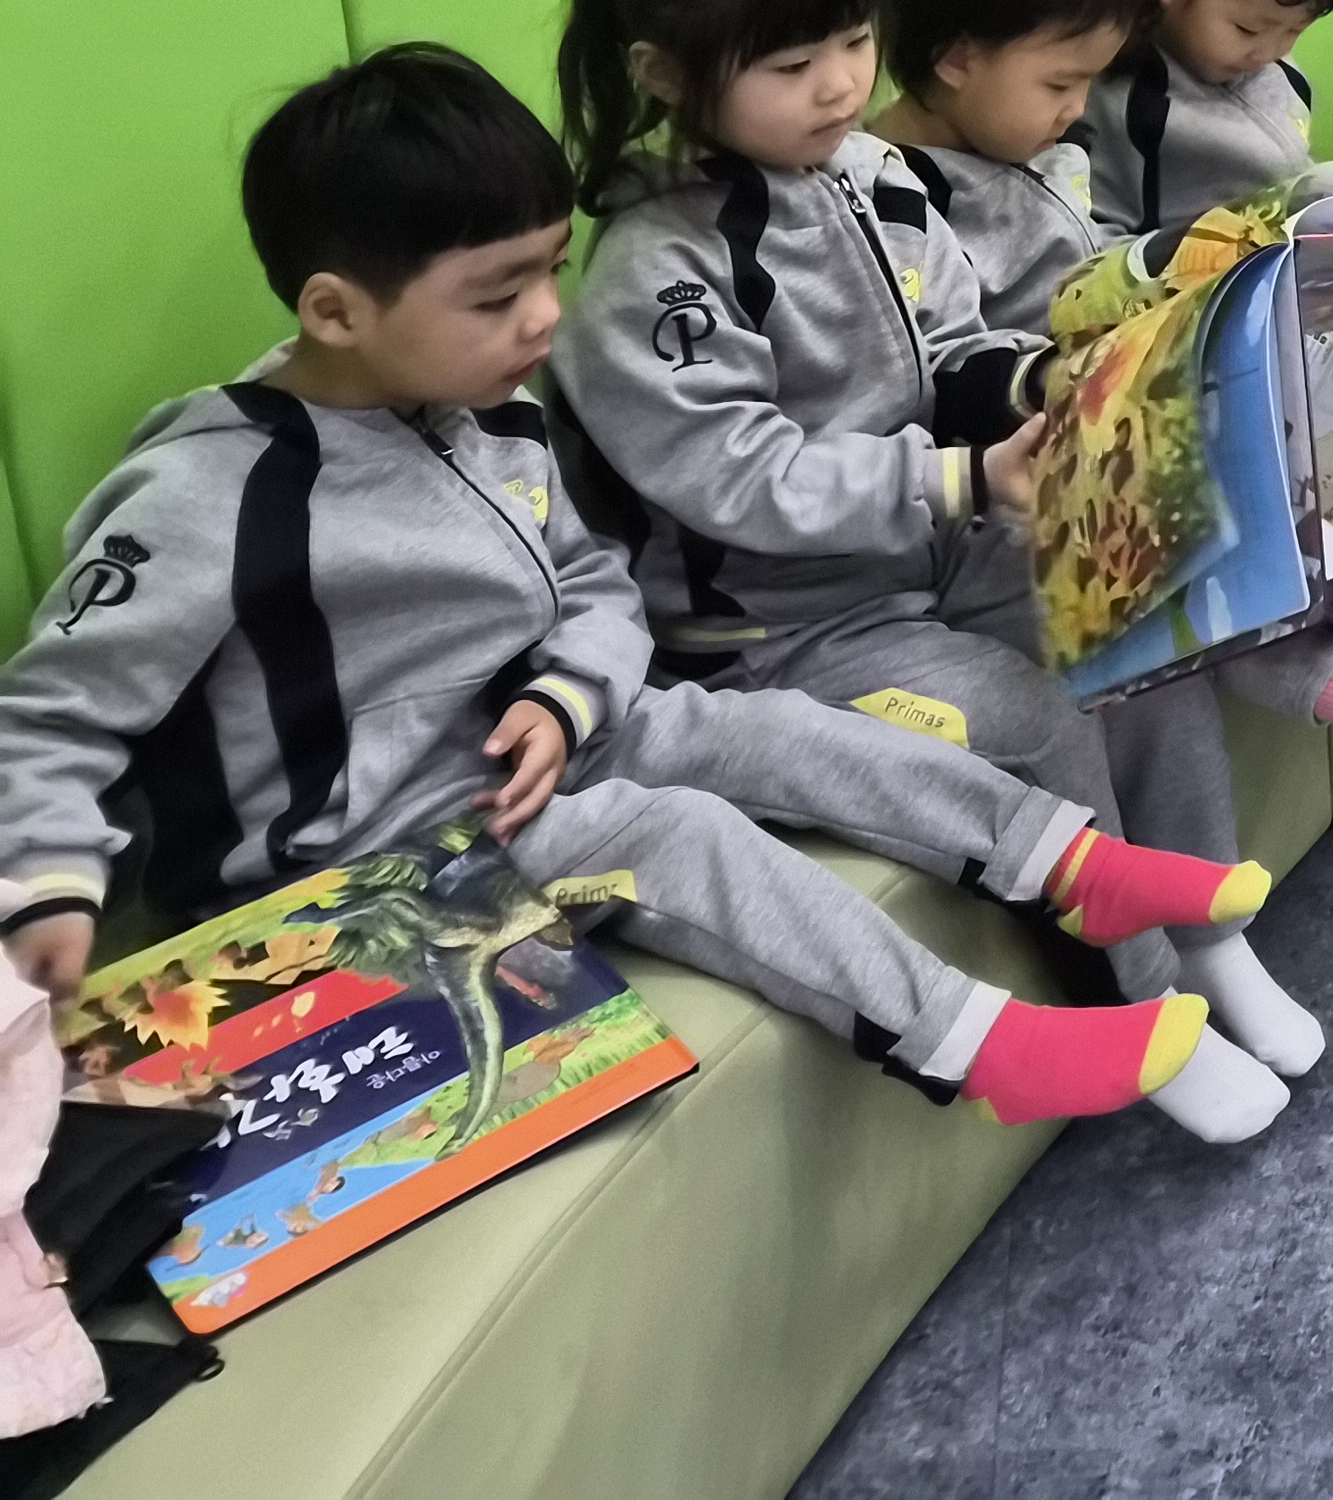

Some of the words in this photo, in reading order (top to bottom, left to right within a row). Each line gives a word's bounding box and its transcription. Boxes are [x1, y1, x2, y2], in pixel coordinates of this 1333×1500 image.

[651, 302, 717, 373] P
[55, 558, 136, 636] P
[884, 696, 946, 728] Primas
[365, 1049, 442, 1090] 아름다운
